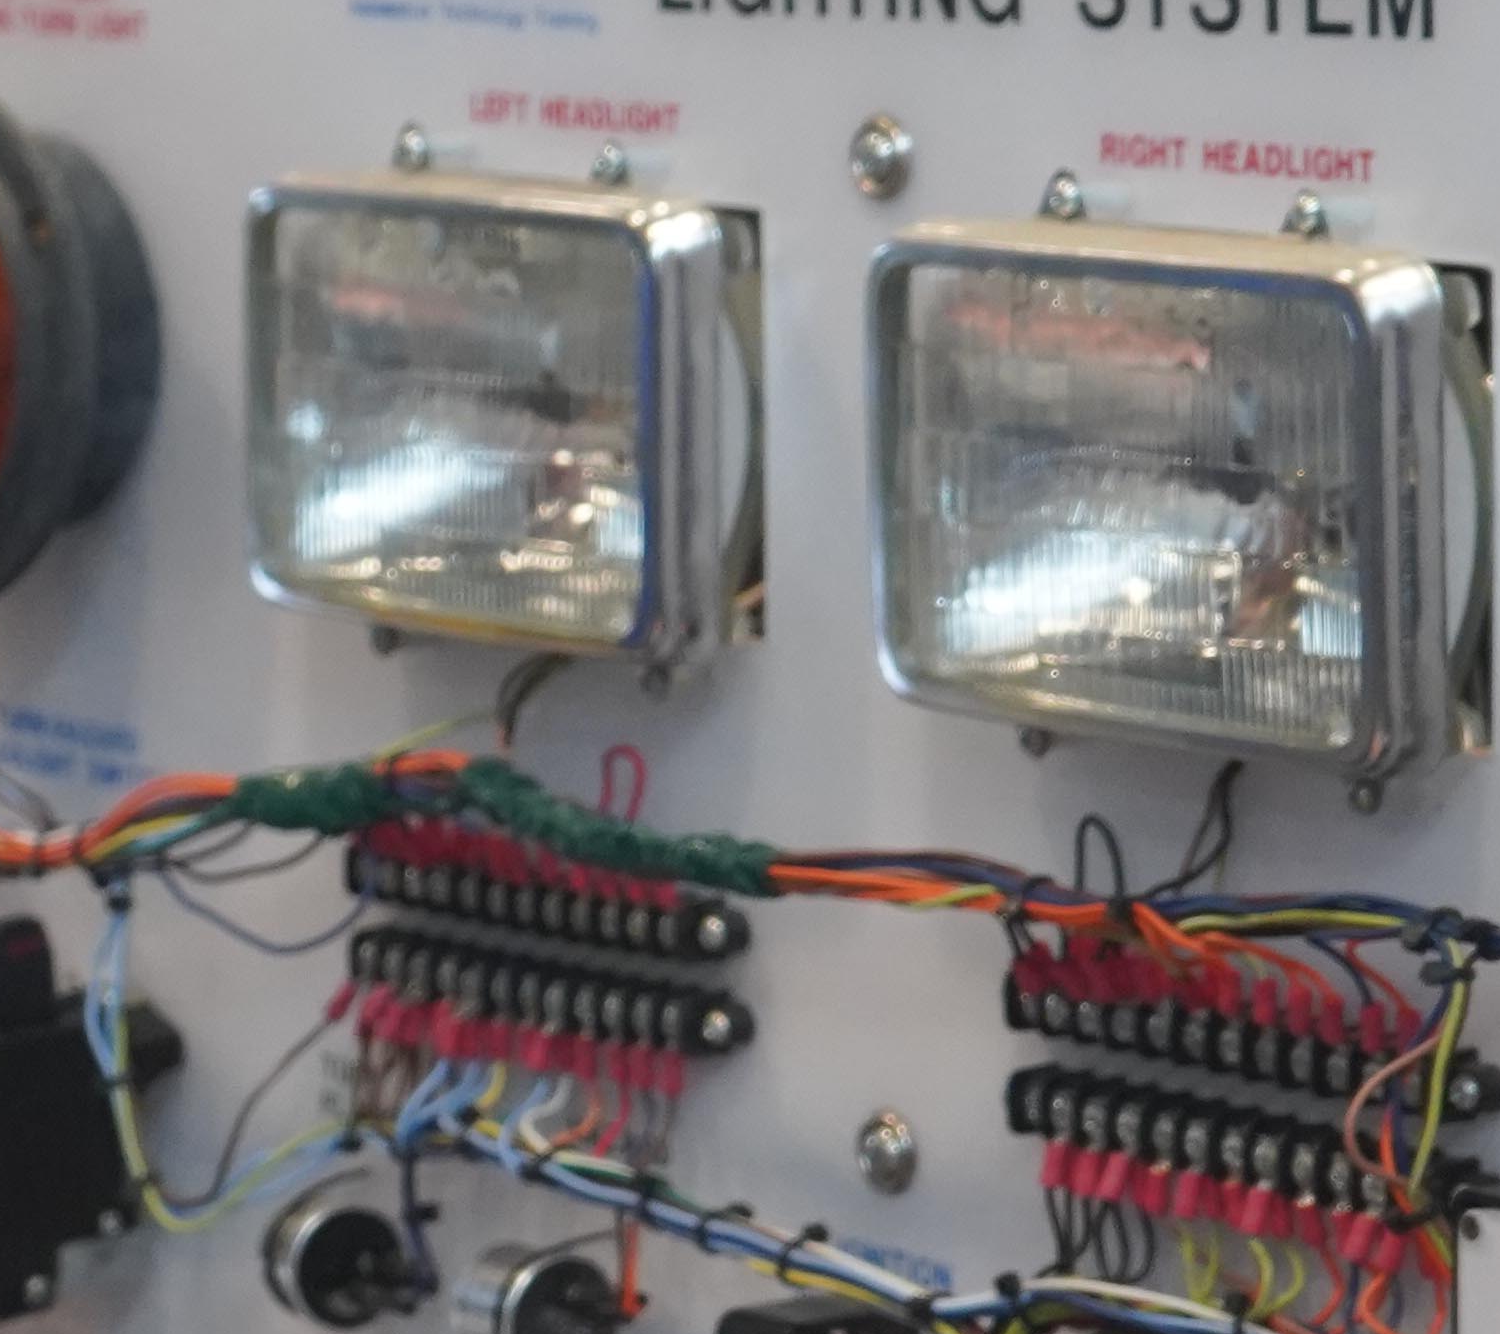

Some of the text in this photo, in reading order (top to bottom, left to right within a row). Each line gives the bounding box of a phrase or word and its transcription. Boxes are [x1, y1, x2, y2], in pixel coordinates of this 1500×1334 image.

[470, 88, 680, 133] LEFT HEADLIGHT
[1099, 132, 1376, 183] RIGHT HEADLIGHT
